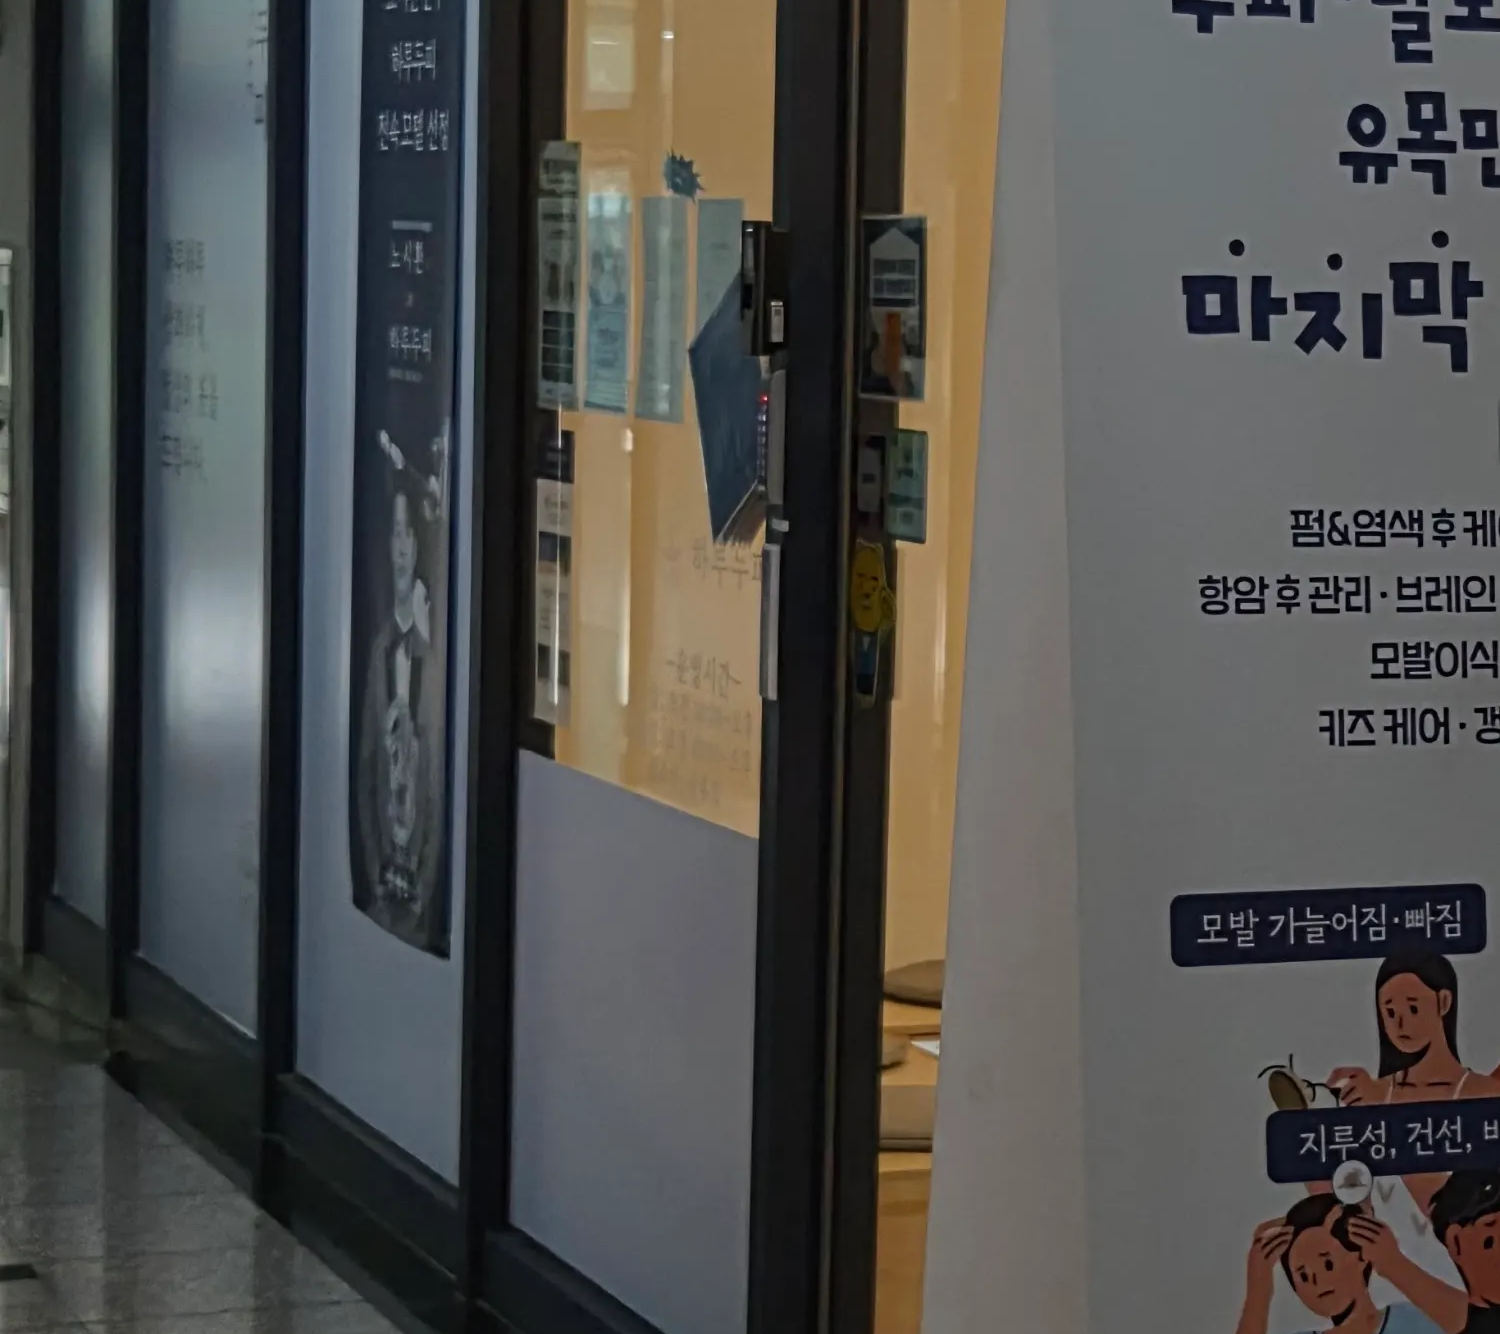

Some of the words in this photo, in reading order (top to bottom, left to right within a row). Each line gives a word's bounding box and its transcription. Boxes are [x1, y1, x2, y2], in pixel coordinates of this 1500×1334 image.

[1182, 231, 1484, 373] 마지막
[1289, 509, 1424, 547] 펌&염색
[1431, 508, 1457, 546] 후
[1199, 575, 1269, 615] 항암
[1275, 574, 1301, 613] 후
[1370, 640, 1499, 680] 모발이식
[1318, 708, 1376, 747] 키즈
[1197, 909, 1260, 948] 모발
[1299, 1121, 1396, 1161] 지루성,
[1407, 1116, 1472, 1157] 건선,
